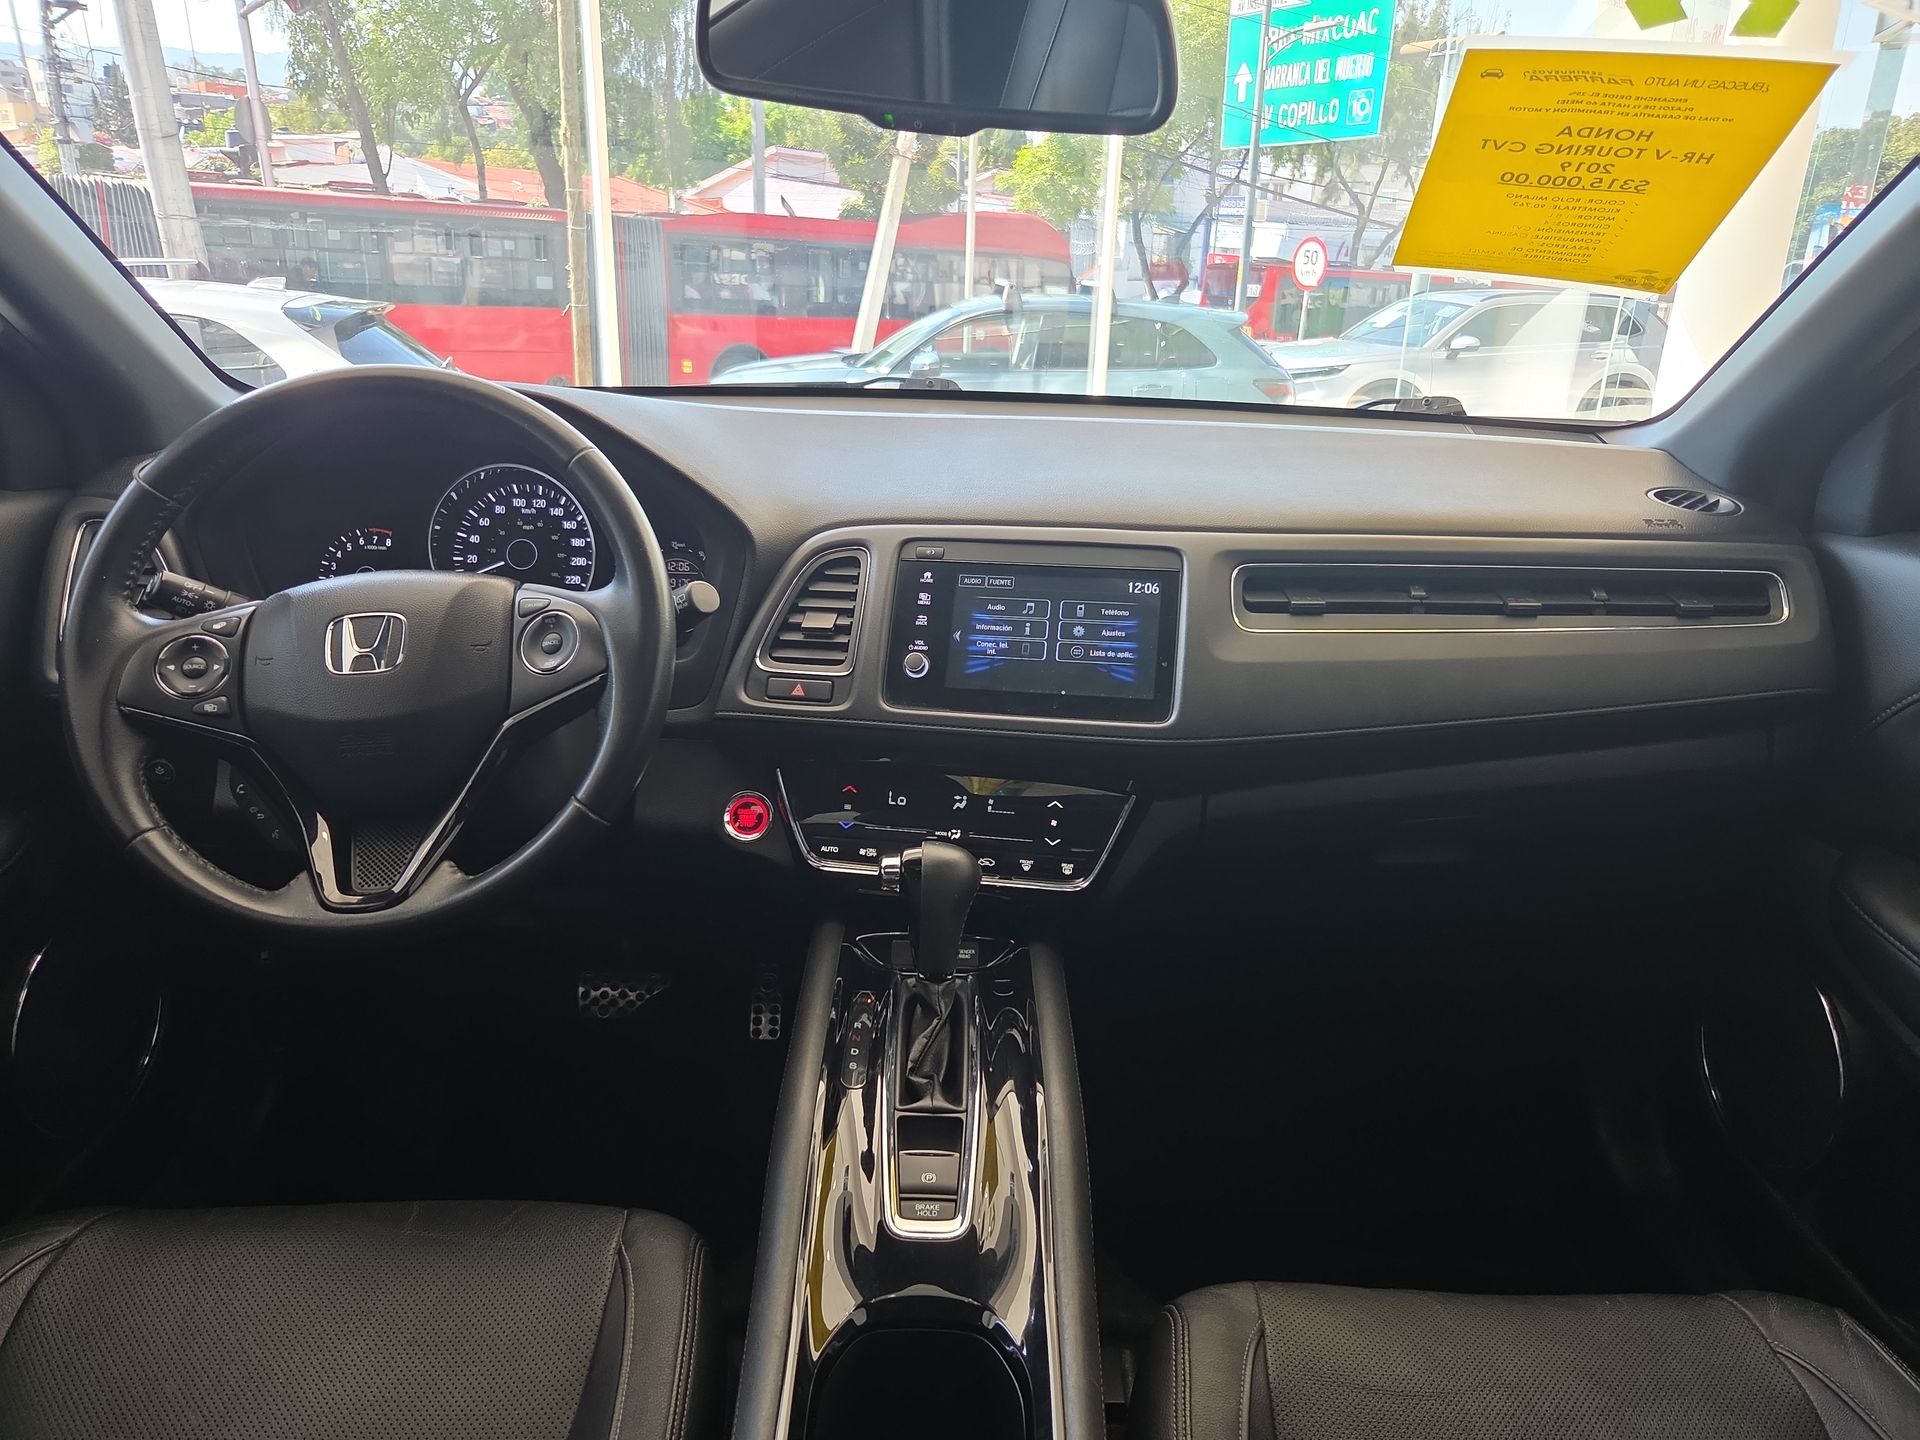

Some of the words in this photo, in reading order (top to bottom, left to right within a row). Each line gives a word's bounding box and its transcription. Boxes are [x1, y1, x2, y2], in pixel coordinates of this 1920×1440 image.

[1263, 60, 1311, 90] BARRANCA
[1313, 57, 1331, 84] DEL
[1303, 249, 1319, 266] 50
[513, 499, 526, 507] 100
[532, 499, 546, 508] 120
[495, 505, 506, 515] 80
[521, 507, 537, 516] km/h
[550, 506, 564, 516] 140
[479, 517, 490, 527] 60
[563, 520, 577, 529] 160
[359, 536, 365, 546] 6
[372, 536, 378, 544] 7
[386, 538, 392, 547] 8
[469, 536, 481, 544] 40
[571, 538, 586, 547] 180
[346, 543, 352, 551] 5
[336, 550, 342, 558] 4
[467, 554, 478, 564] 20
[330, 562, 337, 570] 3
[571, 558, 587, 567] 200
[668, 562, 690, 572] 12:06
[565, 575, 582, 584] 220
[963, 576, 982, 586] AUDIO
[989, 578, 1012, 586] FUENTE
[1128, 582, 1160, 594] 12:06
[171, 595, 191, 608] AUTO
[987, 602, 1006, 612] Audio
[1101, 608, 1130, 618] Teléfono
[976, 622, 1013, 632] Información
[1101, 630, 1126, 638] Ajustes
[976, 640, 998, 650] Conec.
[1090, 648, 1106, 658] Lista
[1106, 650, 1116, 658] de
[1116, 650, 1135, 660] aplic.
[888, 790, 907, 806] Lo
[820, 845, 840, 854] AUTO
